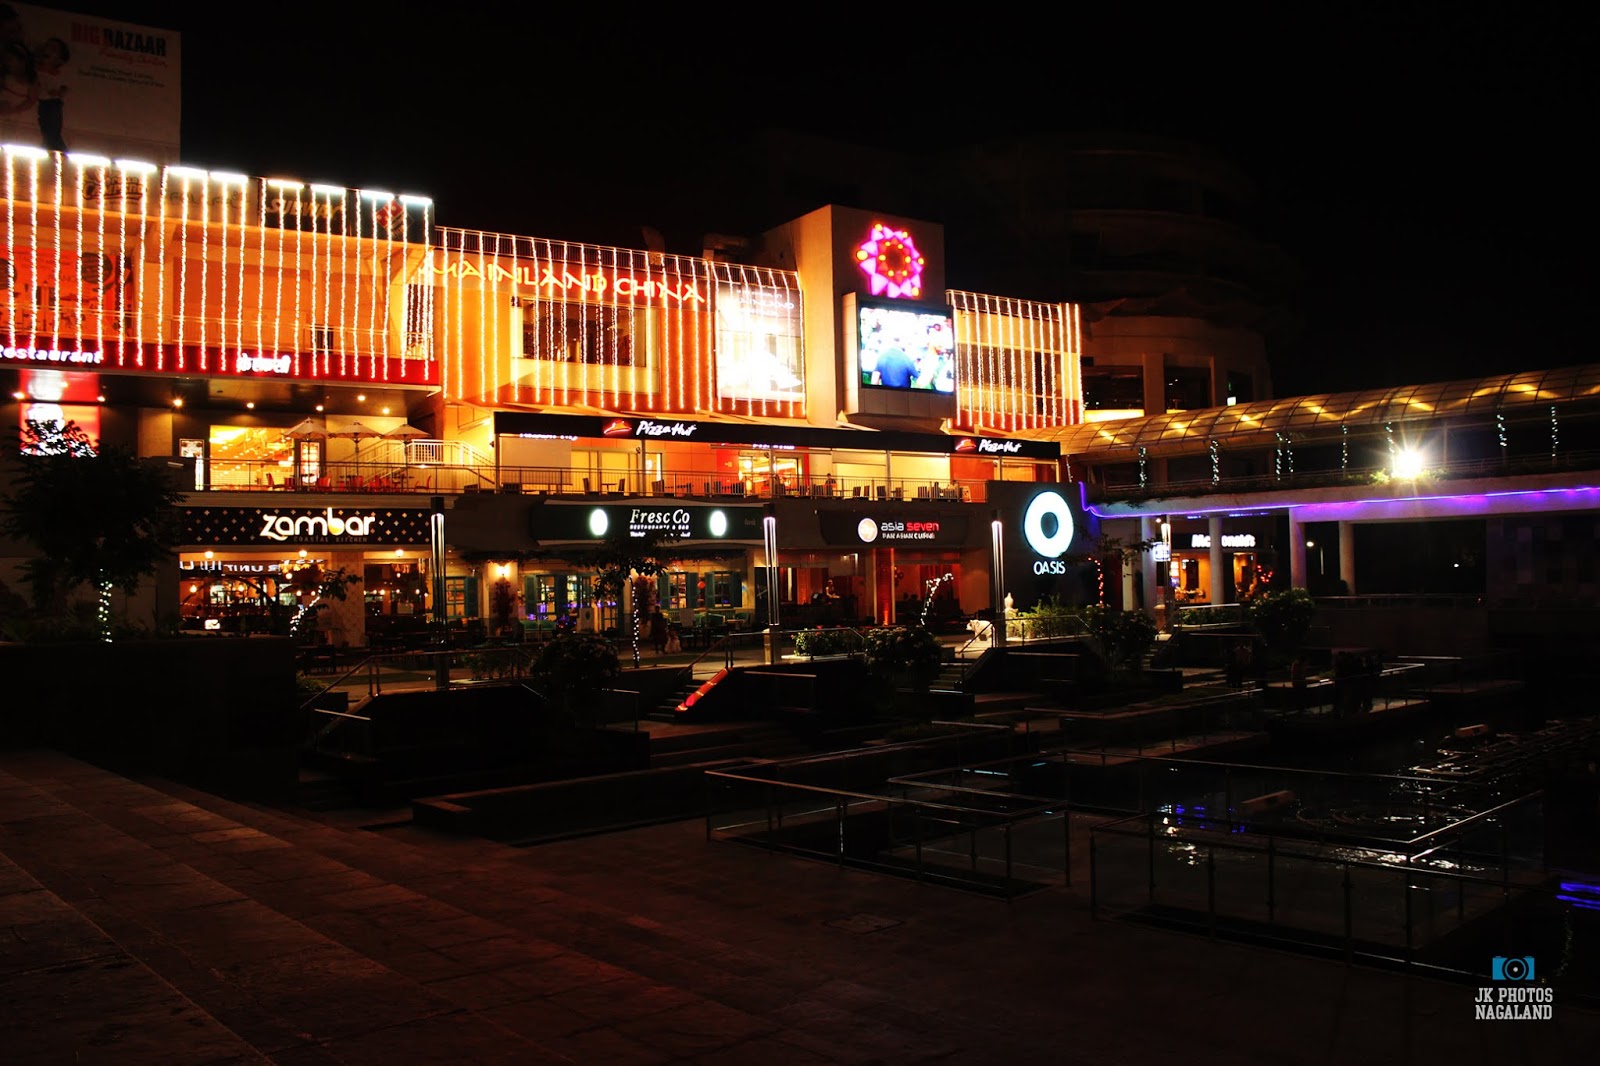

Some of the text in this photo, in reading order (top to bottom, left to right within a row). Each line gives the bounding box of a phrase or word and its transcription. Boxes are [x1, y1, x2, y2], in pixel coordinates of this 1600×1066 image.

[102, 28, 167, 57] BAZAAR
[266, 198, 345, 219] SUBWAY
[418, 259, 607, 294] MAINLAND
[614, 276, 705, 303] CHINA
[636, 420, 697, 436] Pizza Hut
[978, 438, 1022, 453] Pizza Hut
[259, 506, 376, 542] zambar
[880, 521, 940, 532] asia seven
[1191, 534, 1256, 548] Mconald's
[1033, 560, 1066, 576] OASIS
